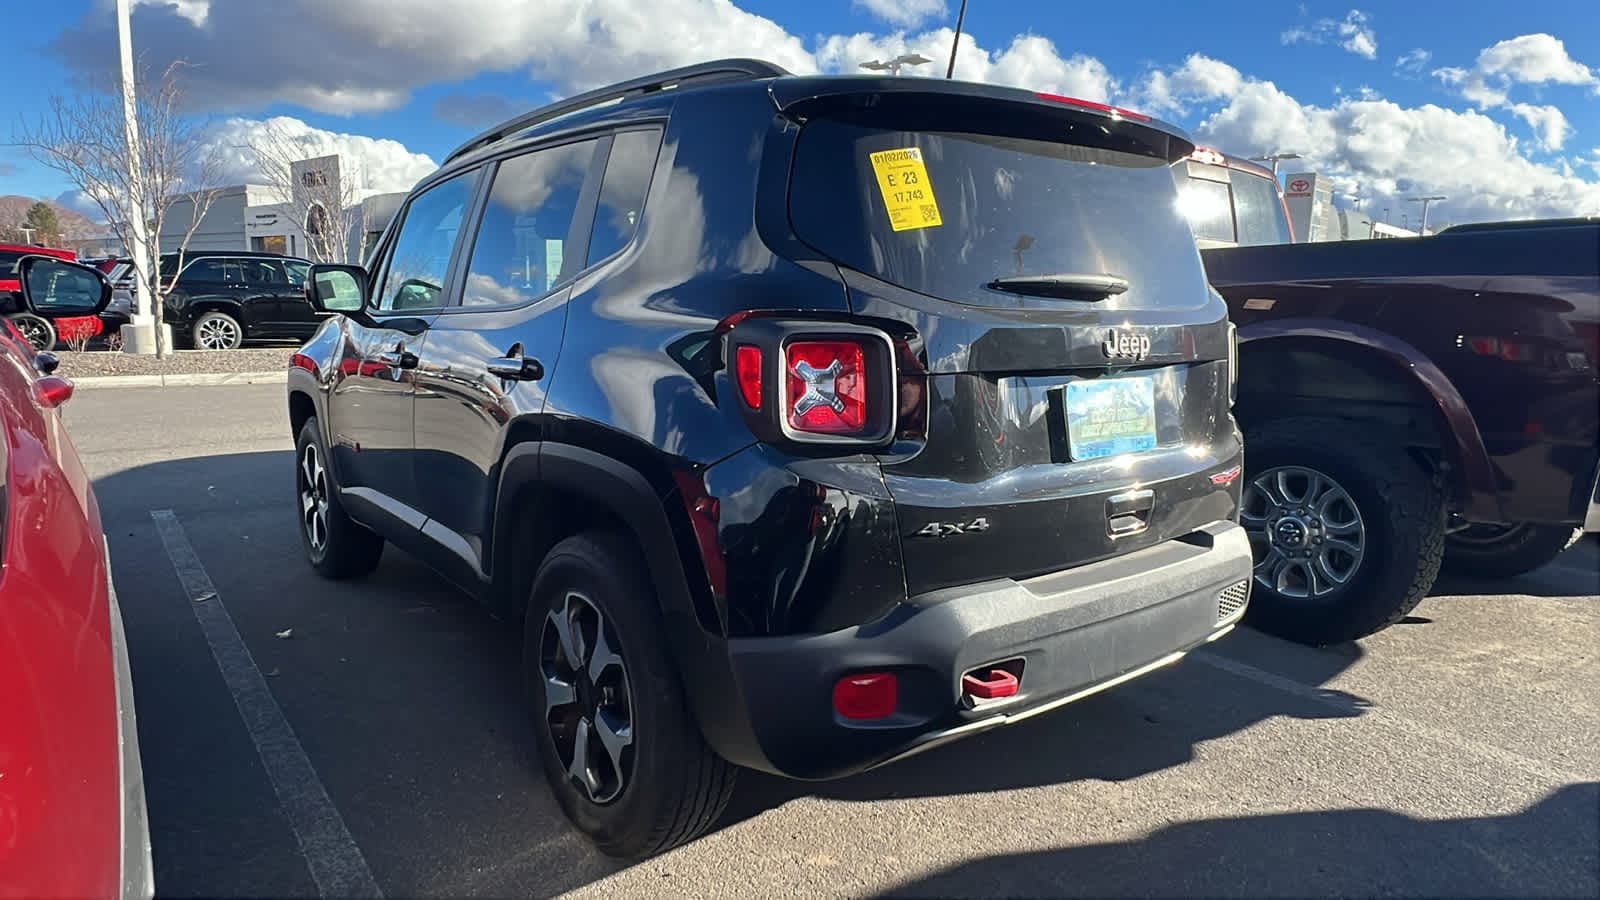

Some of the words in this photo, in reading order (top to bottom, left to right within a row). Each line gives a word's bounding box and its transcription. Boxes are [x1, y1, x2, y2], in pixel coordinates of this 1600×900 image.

[887, 174, 896, 187] E
[902, 171, 918, 185] 23
[1104, 329, 1151, 361] Jeep
[917, 517, 990, 537] 4x4
